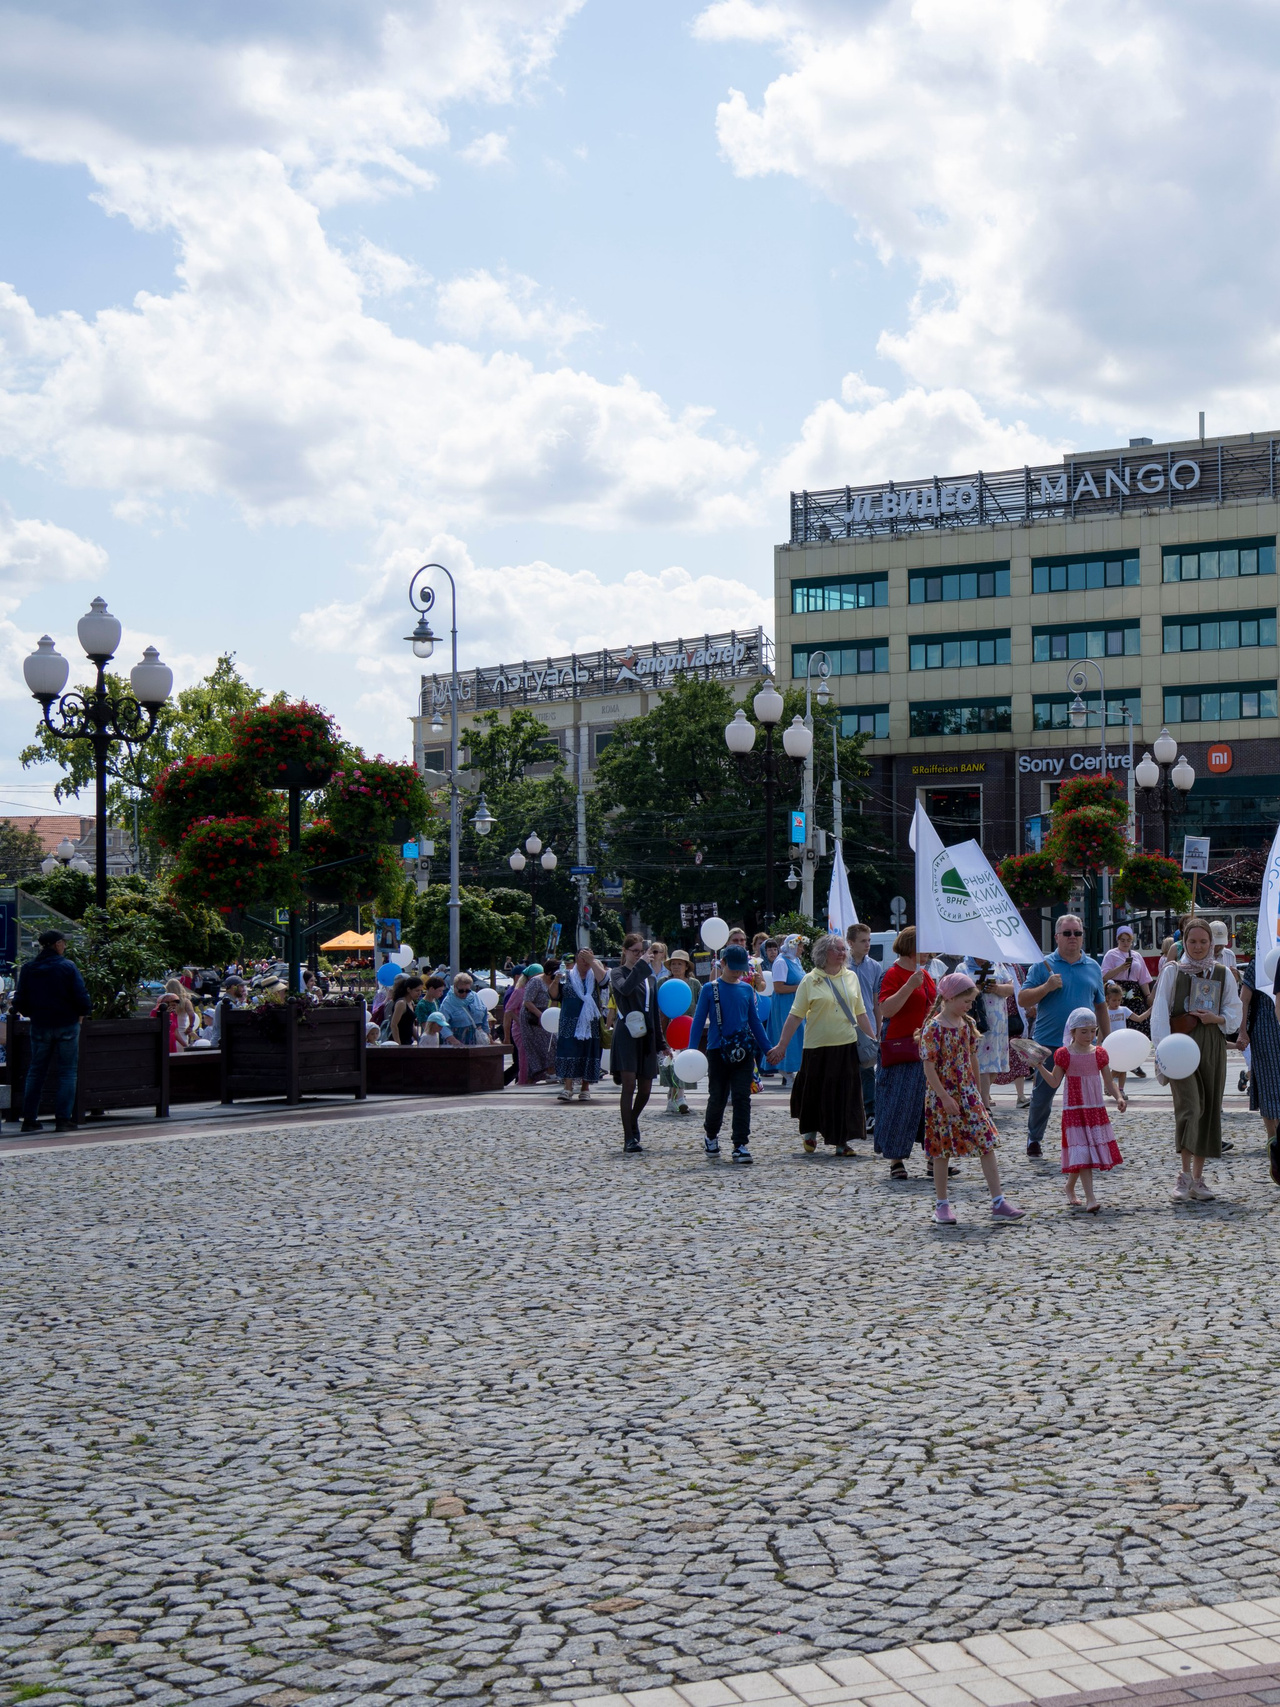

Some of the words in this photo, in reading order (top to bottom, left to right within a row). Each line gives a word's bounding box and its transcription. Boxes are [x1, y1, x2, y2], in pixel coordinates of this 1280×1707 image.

[1040, 459, 1201, 501] MANGO
[919, 765, 959, 775] Raiffeisen
[960, 762, 986, 773] BANK
[1018, 755, 1066, 776] Sony
[946, 896, 969, 906] ВРНС
